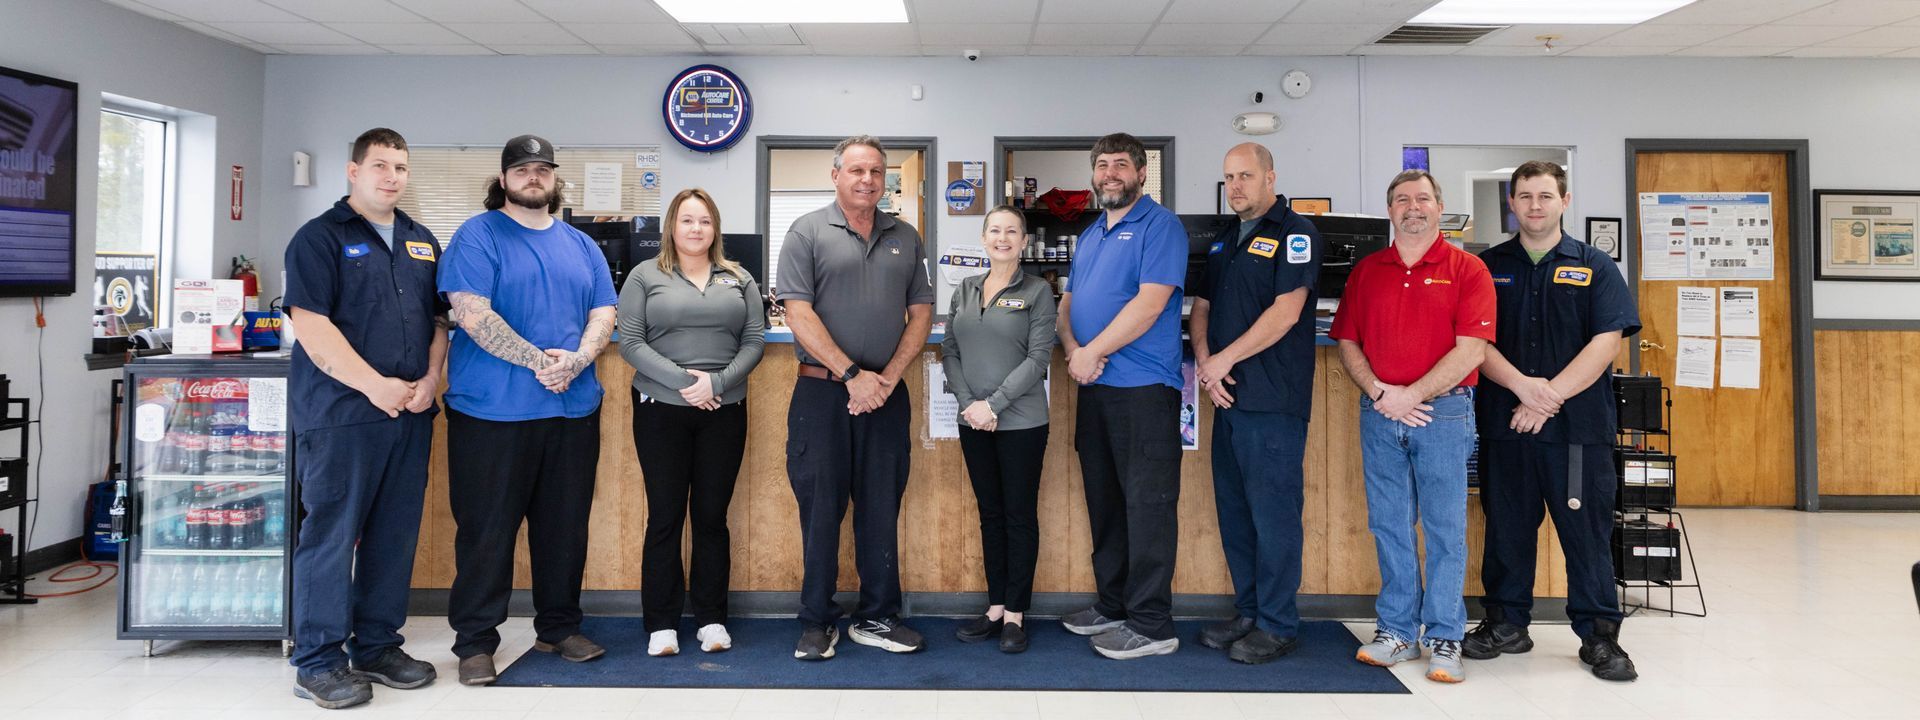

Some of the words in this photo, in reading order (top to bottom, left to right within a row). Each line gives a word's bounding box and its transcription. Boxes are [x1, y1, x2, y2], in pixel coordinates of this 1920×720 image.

[0, 149, 34, 172] ould
[37, 149, 55, 175] be
[637, 154, 659, 162] RHBC
[106, 256, 146, 270] SUPPORTER
